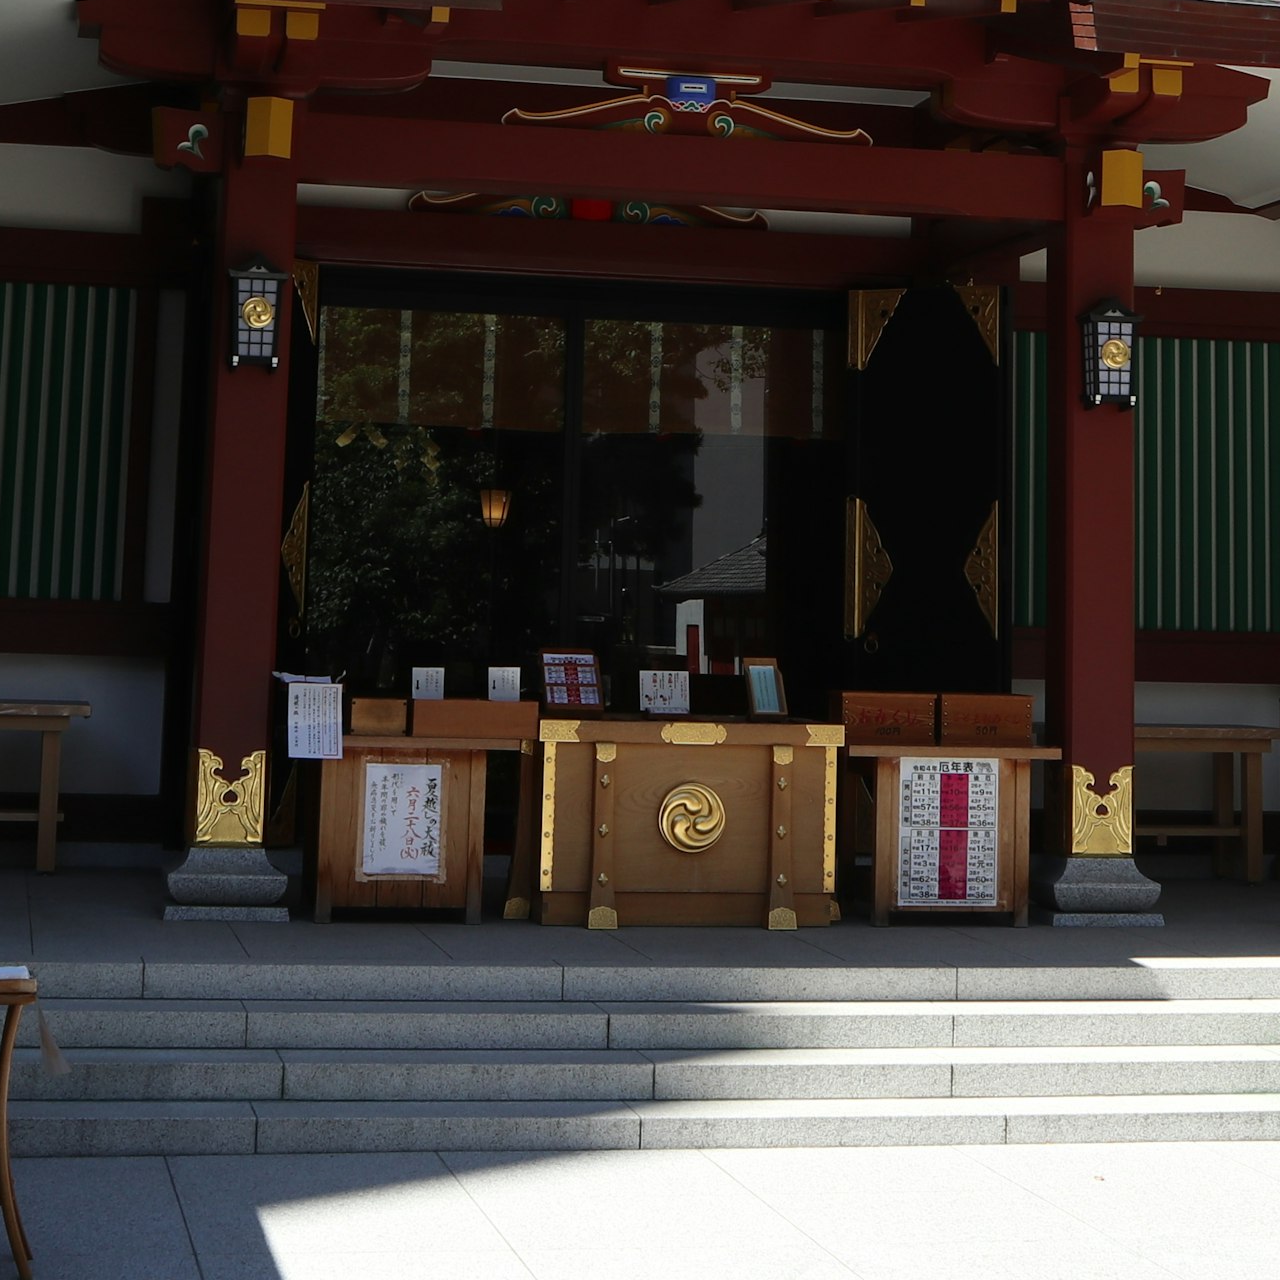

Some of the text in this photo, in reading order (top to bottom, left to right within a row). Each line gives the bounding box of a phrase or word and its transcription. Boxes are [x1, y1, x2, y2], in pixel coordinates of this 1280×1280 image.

[939, 761, 973, 773] 厄年表
[421, 778, 438, 858] 夏越しの大祓
